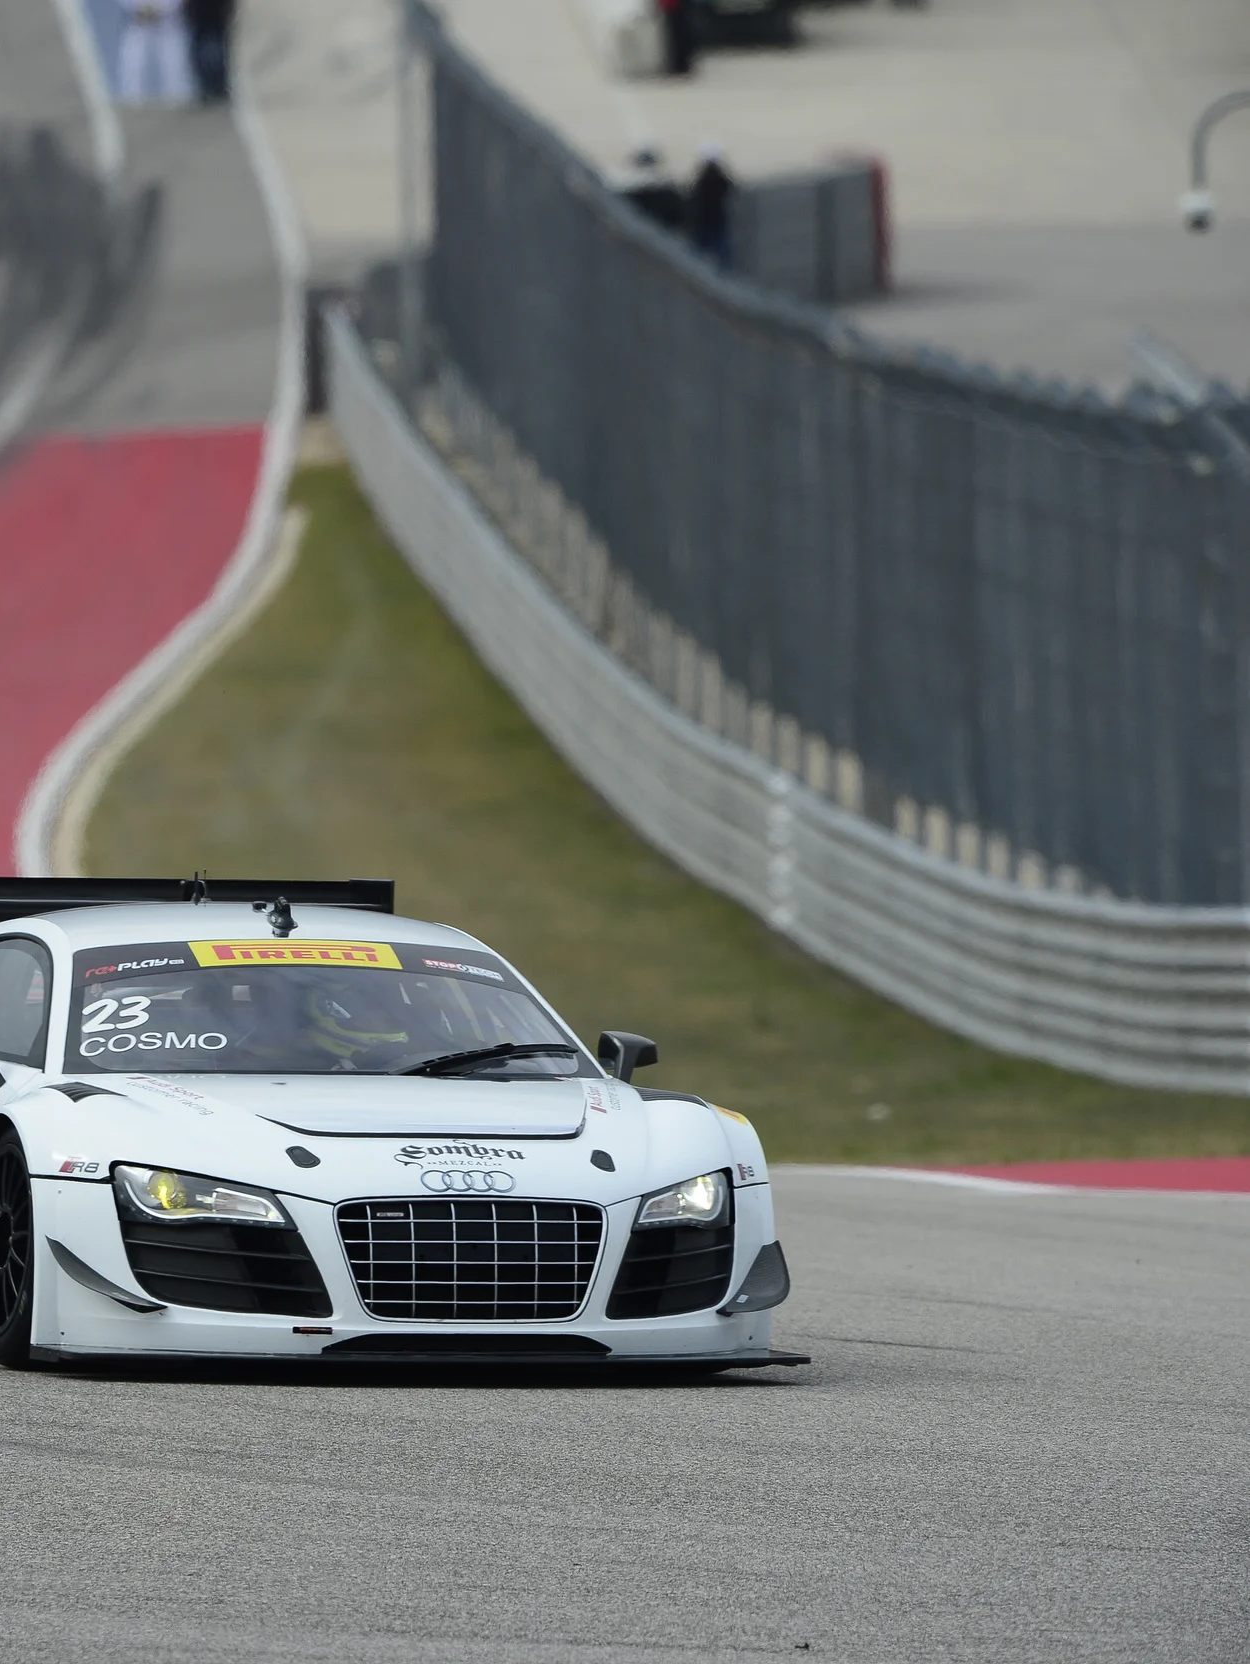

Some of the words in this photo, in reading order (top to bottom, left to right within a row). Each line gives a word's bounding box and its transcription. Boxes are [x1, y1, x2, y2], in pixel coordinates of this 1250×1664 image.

[212, 944, 379, 962] PIRELLI
[82, 996, 151, 1033] 23
[79, 1031, 228, 1057] COSMO
[394, 1139, 526, 1167] Sombra
[68, 1161, 100, 1173] R8
